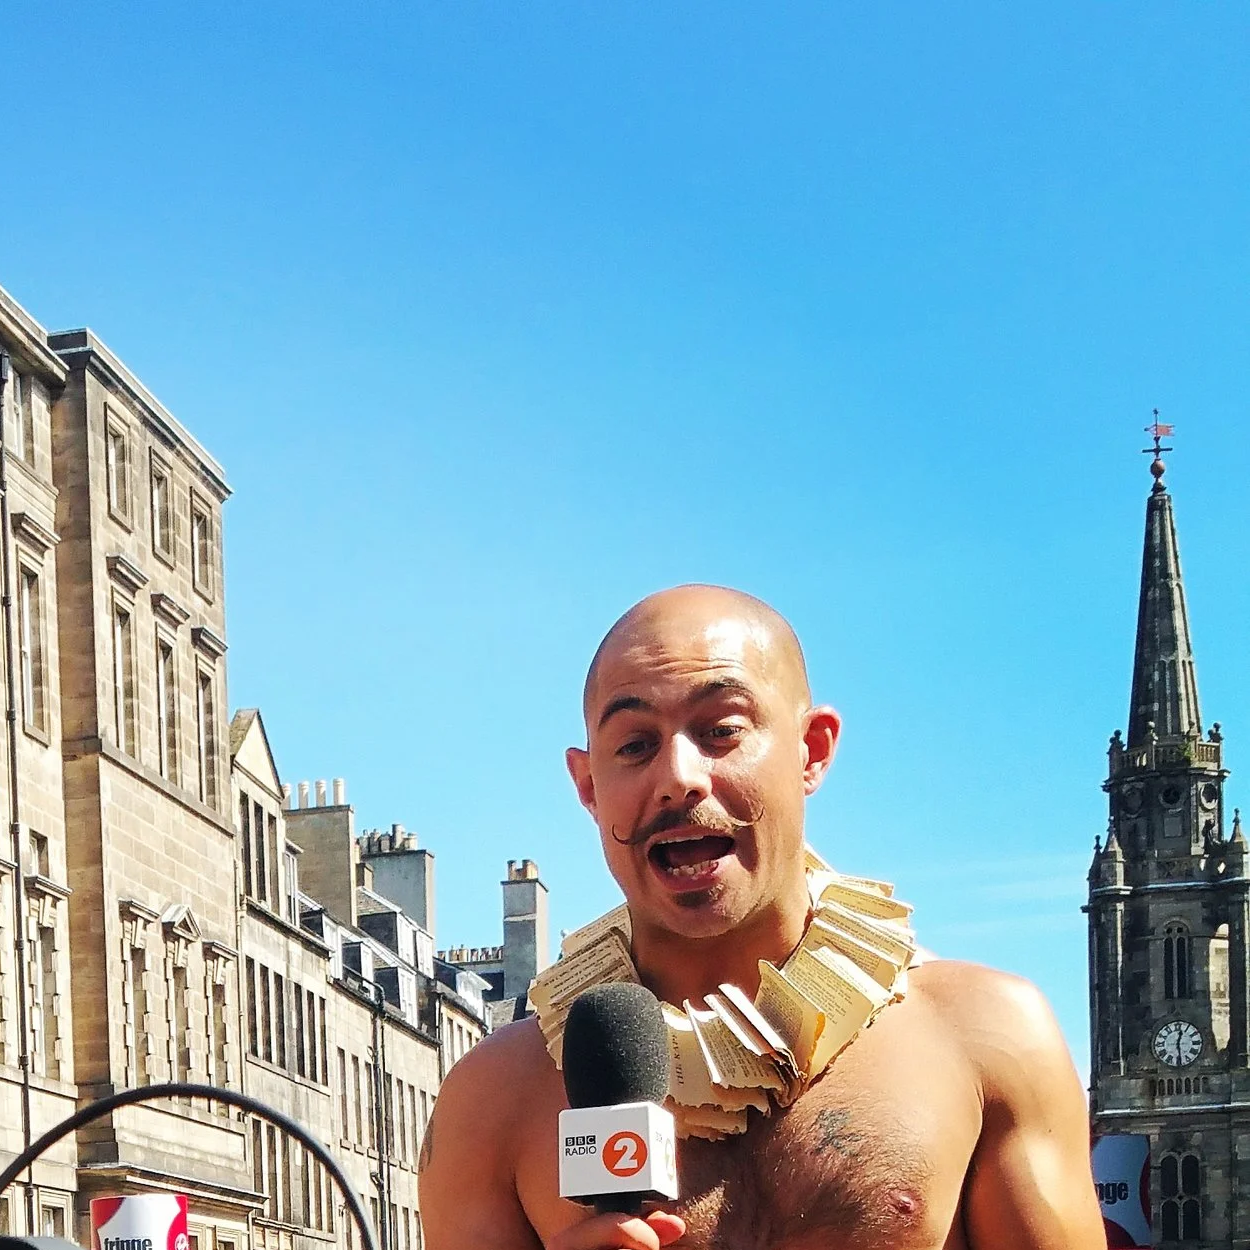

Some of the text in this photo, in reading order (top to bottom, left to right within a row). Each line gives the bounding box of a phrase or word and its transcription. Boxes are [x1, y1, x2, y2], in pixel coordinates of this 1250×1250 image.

[565, 1135, 596, 1147] BBC
[565, 1146, 597, 1156] RADIO
[613, 1137, 639, 1170] 2
